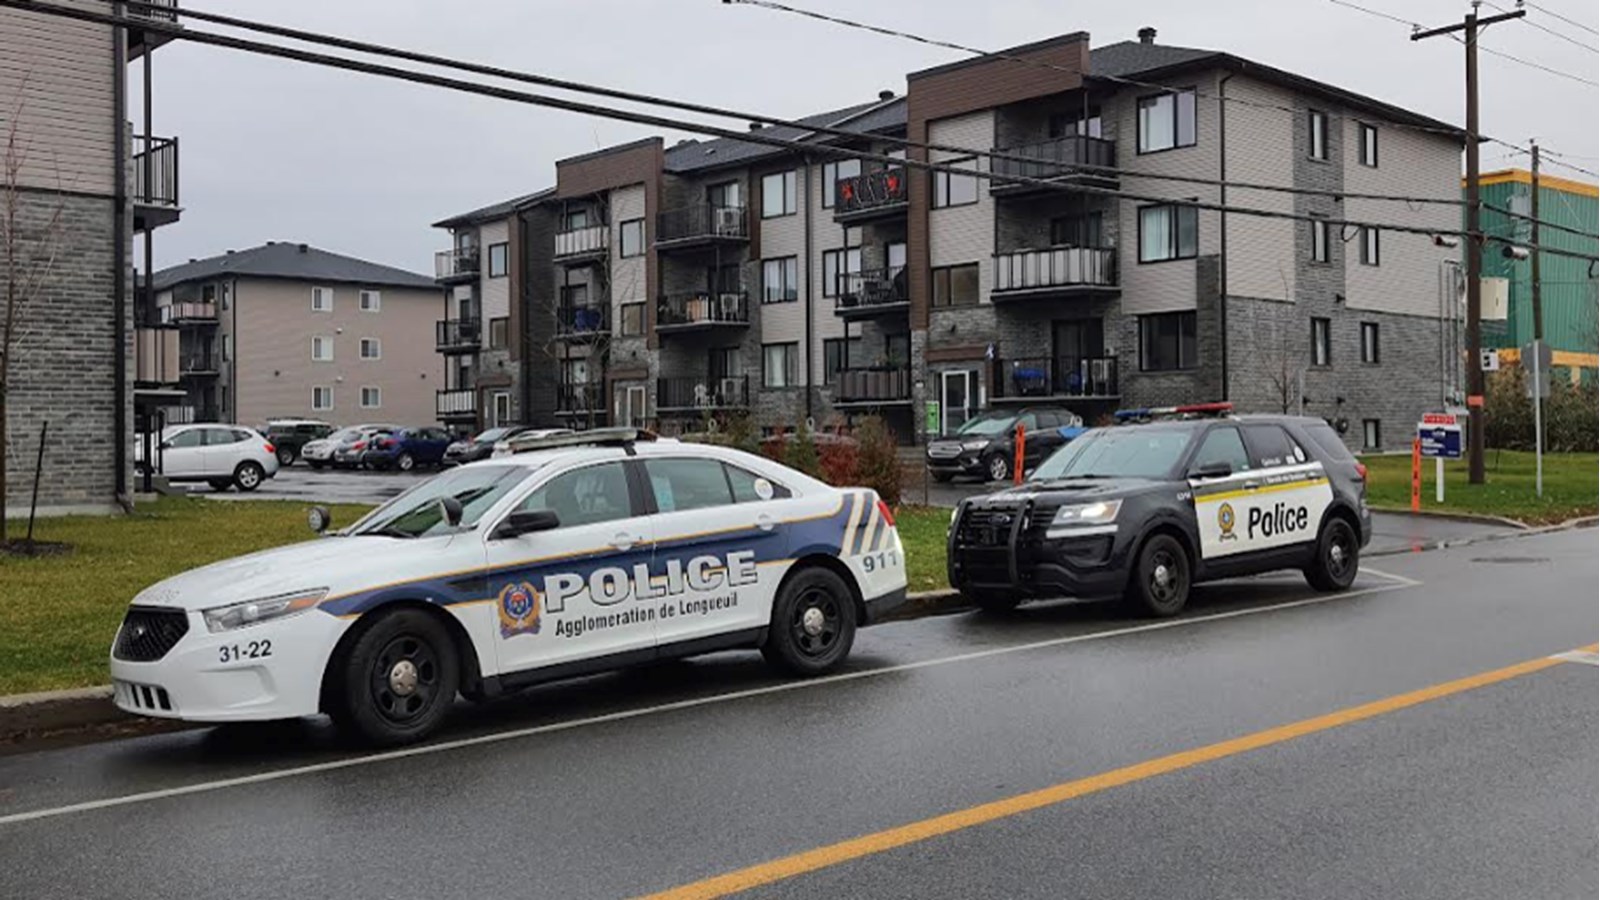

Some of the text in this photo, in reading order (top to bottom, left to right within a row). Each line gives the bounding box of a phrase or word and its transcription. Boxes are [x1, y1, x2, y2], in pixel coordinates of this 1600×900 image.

[1248, 502, 1308, 540] Police
[863, 551, 897, 573] 911
[543, 549, 758, 614] POLICE
[555, 592, 738, 638] Agglomeration de Longueuil
[219, 639, 272, 662] 31-22
